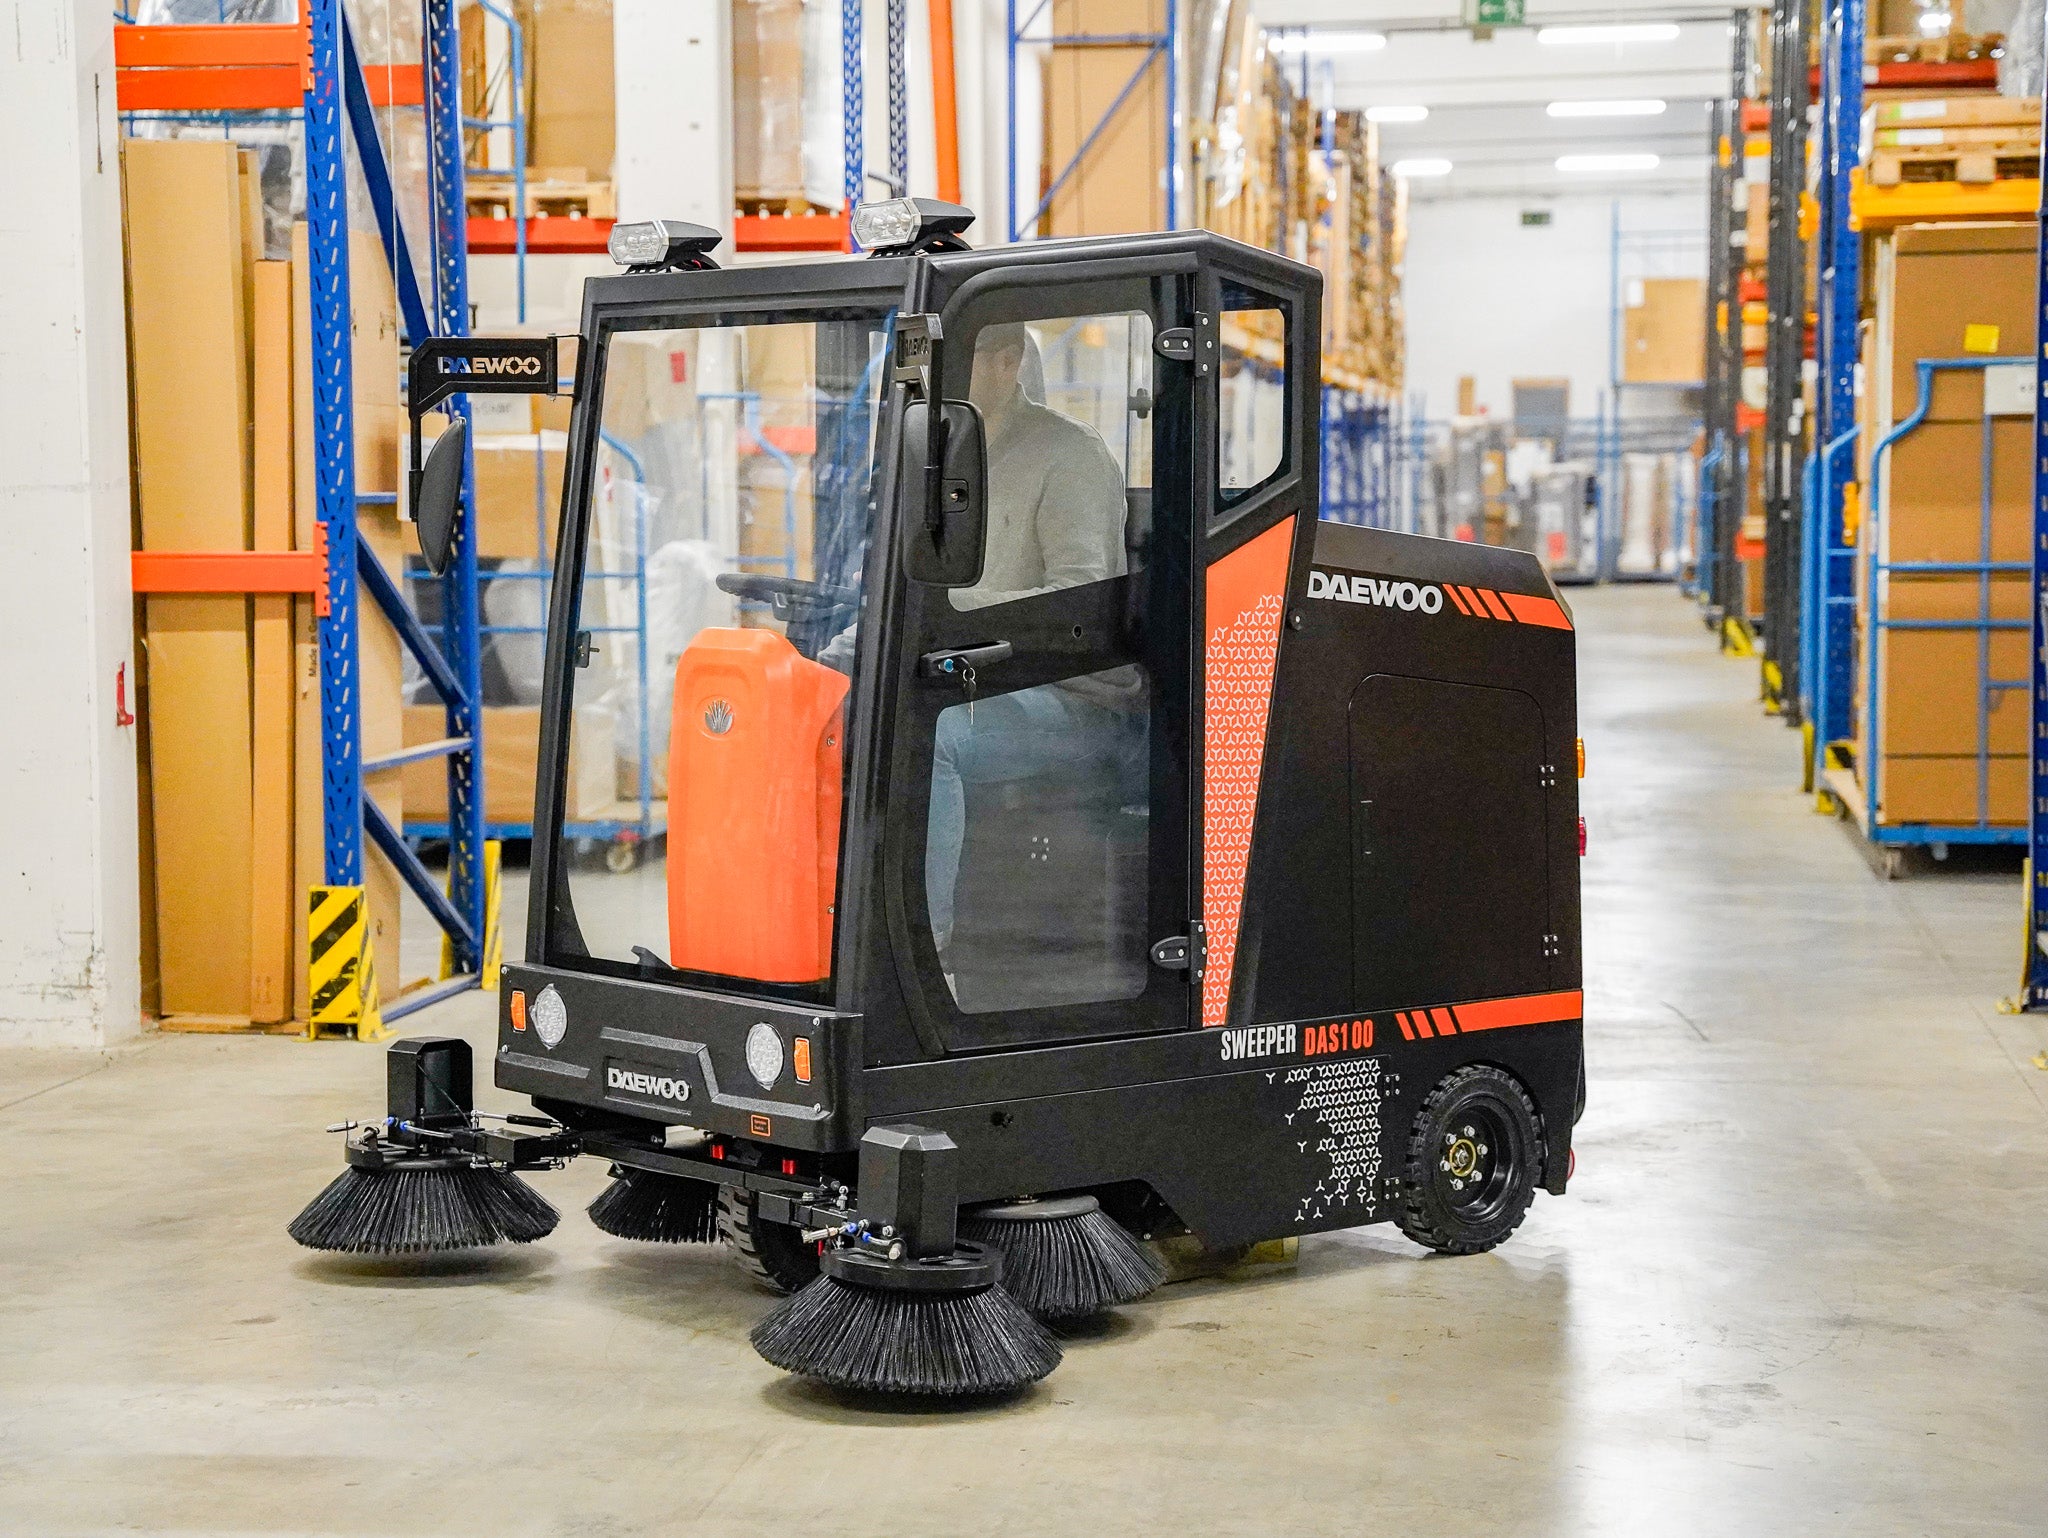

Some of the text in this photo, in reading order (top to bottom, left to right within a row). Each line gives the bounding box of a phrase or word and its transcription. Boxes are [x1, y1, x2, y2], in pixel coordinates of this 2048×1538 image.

[437, 356, 541, 375] DAEWOO
[1307, 570, 1444, 615] DAEWOO
[308, 648, 317, 677] Made
[1220, 1019, 1374, 1061] SWEEPER DAS100
[607, 1067, 690, 1102] DAEWOO
